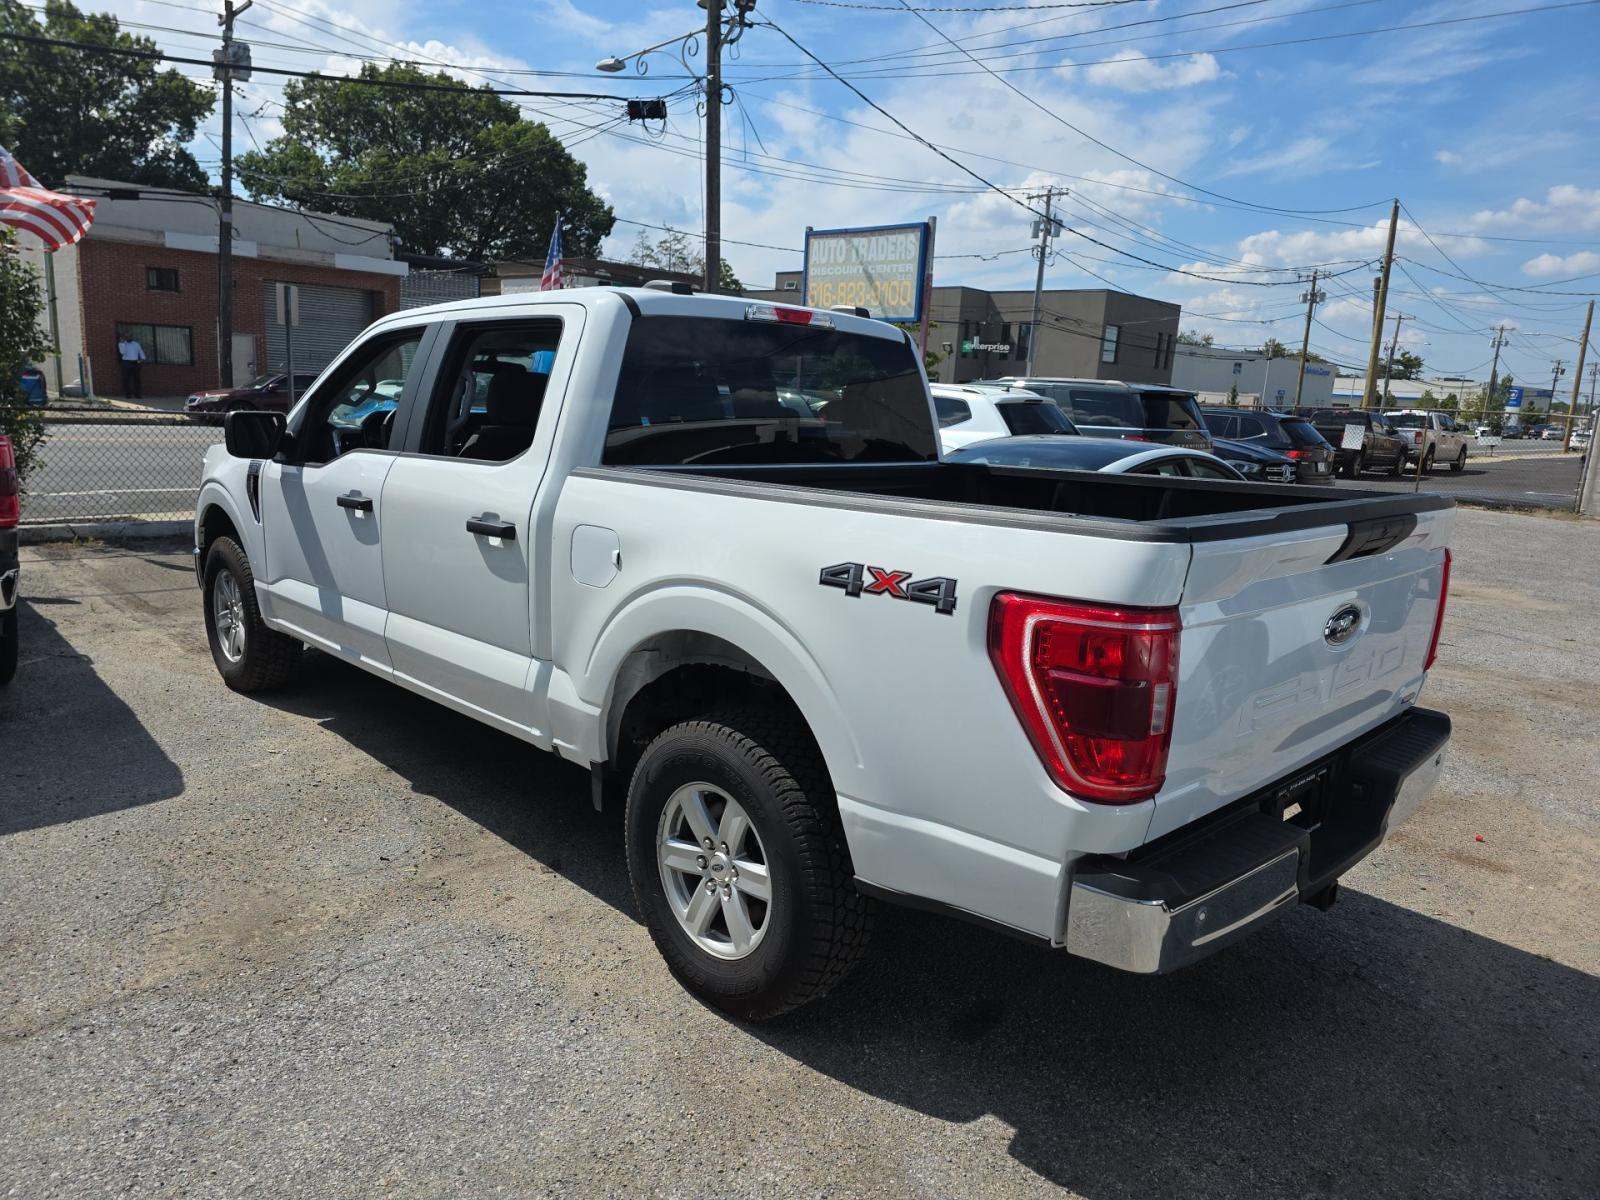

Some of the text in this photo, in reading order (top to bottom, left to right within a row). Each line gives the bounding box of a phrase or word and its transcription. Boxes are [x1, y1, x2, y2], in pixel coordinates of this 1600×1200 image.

[811, 232, 917, 265] AUTO TRADERS
[867, 262, 913, 274] CENTER
